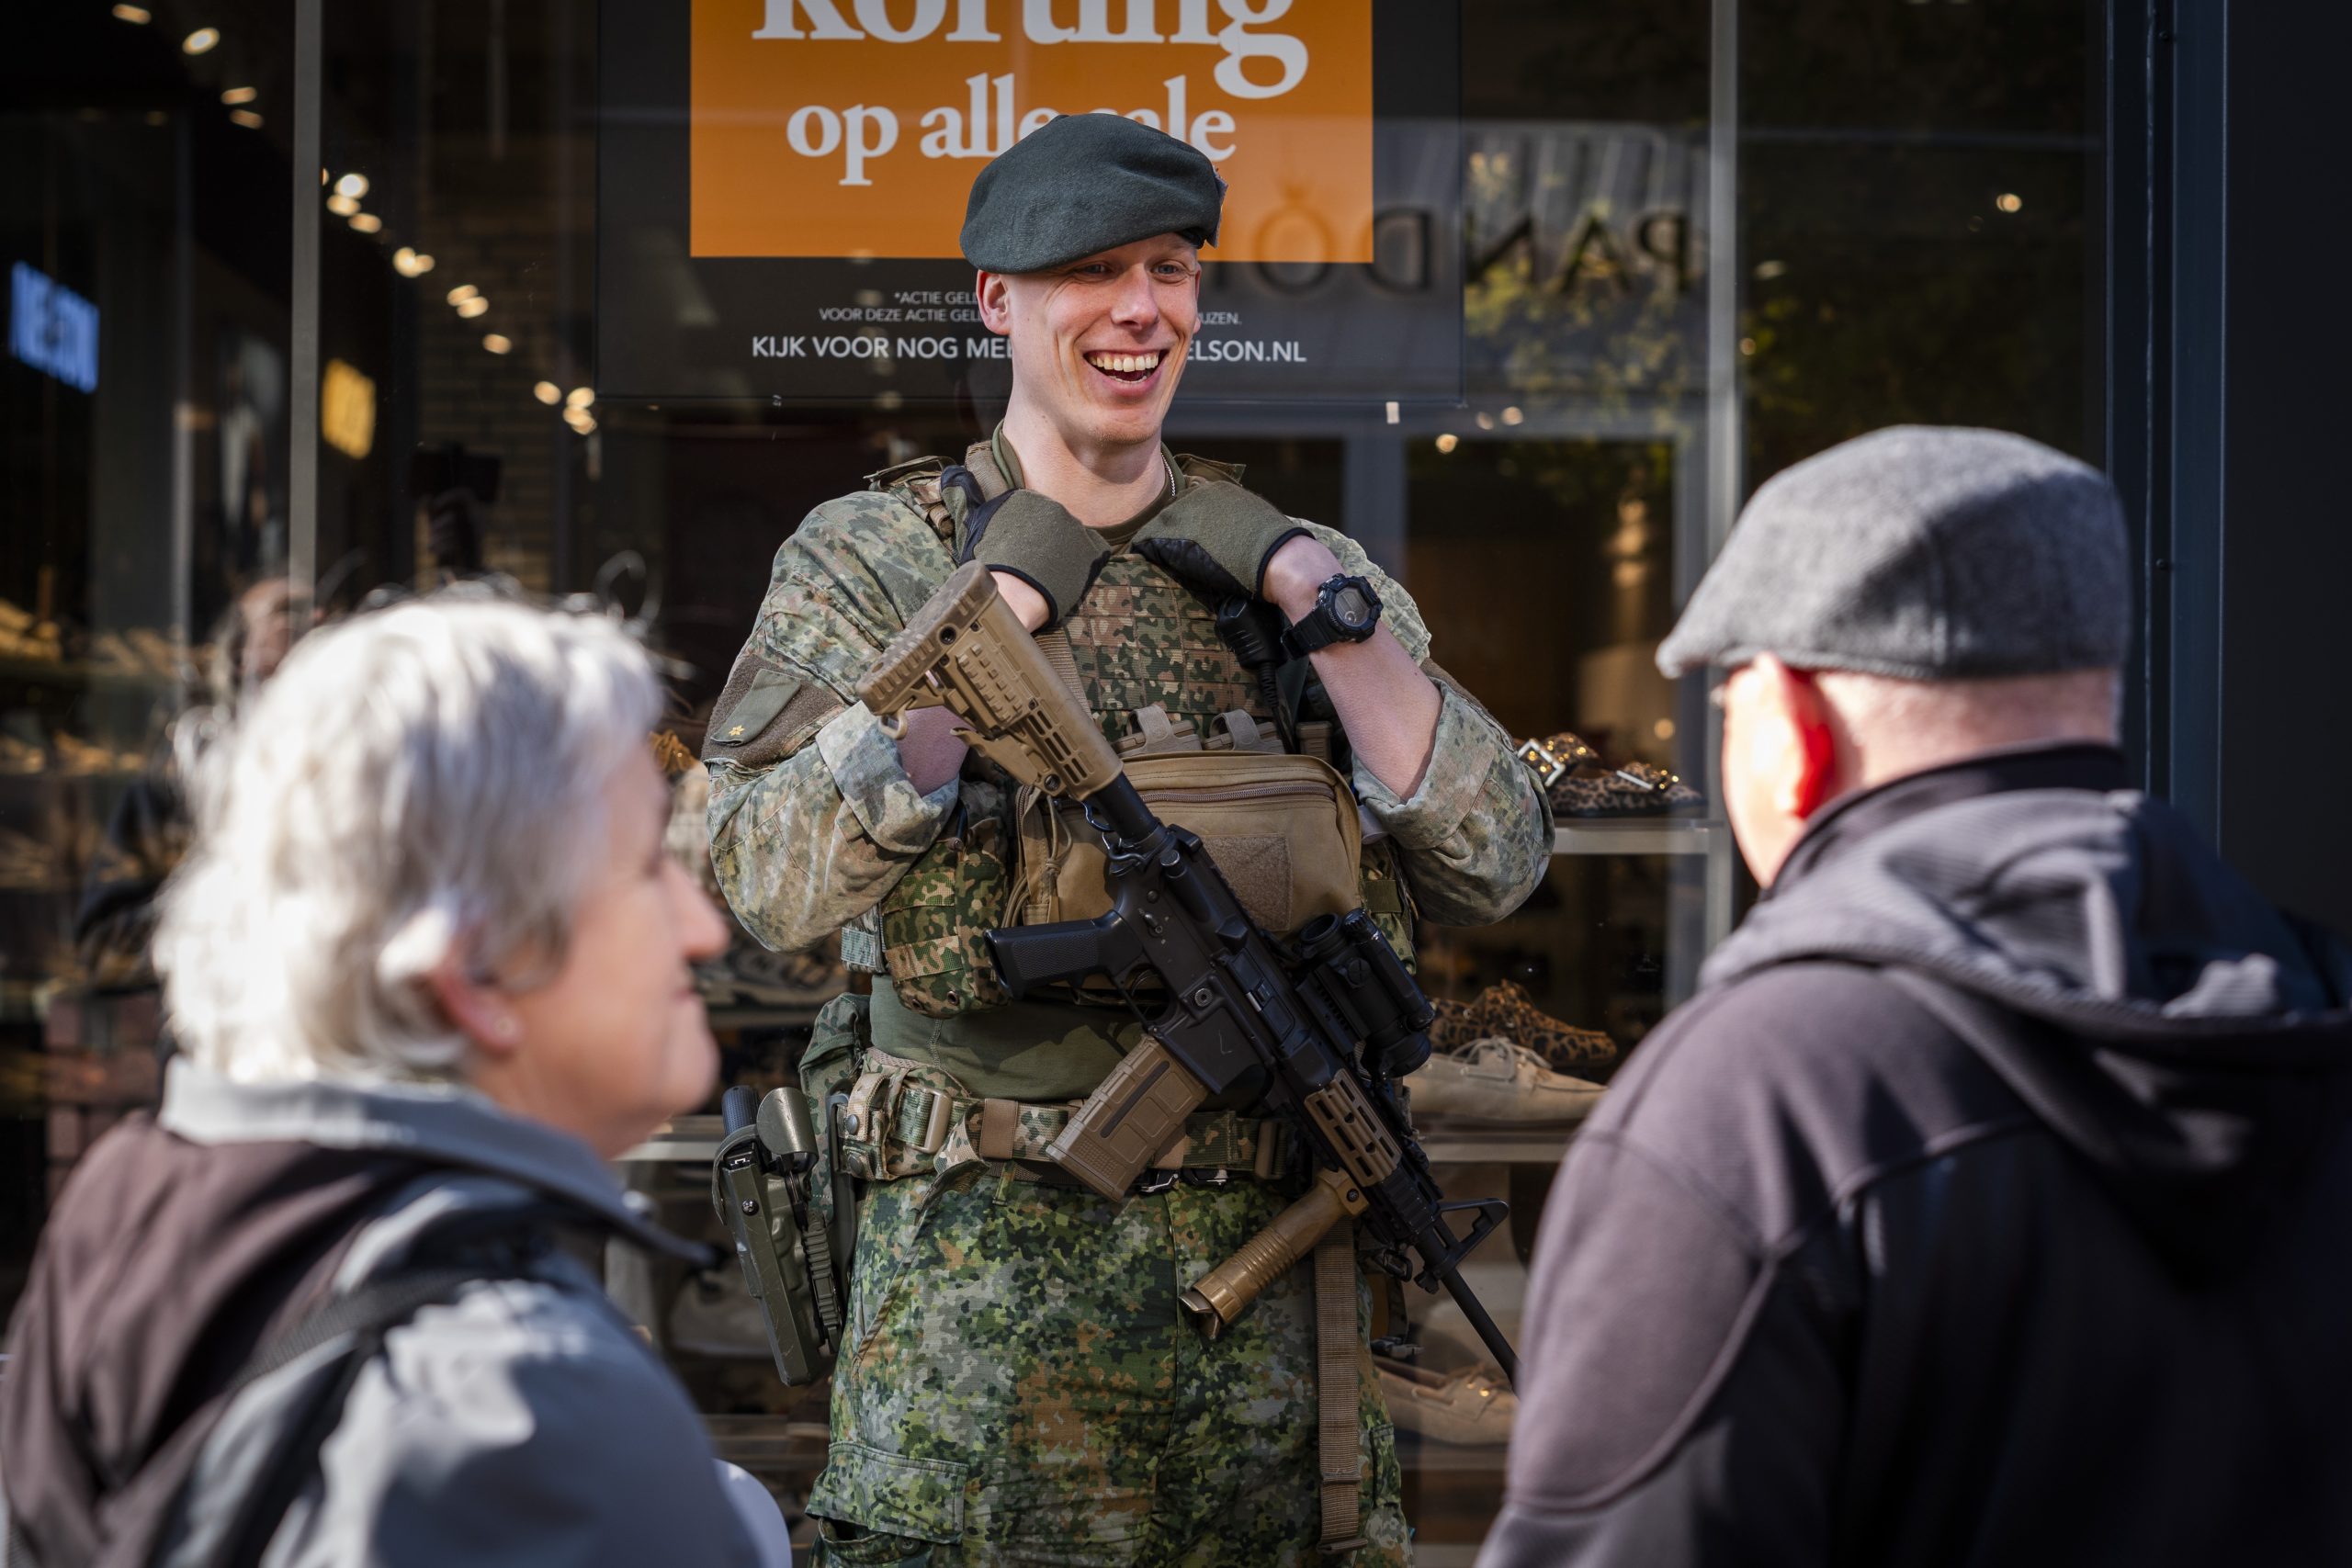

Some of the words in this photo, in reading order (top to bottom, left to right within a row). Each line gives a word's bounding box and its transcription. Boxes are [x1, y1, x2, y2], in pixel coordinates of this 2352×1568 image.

[787, 105, 899, 186] op
[1087, 74, 1236, 162] le
[820, 308, 862, 321] VOOR
[865, 309, 901, 321] DEZE
[904, 309, 946, 321] ACTIE
[752, 336, 806, 357] KIJK
[811, 336, 889, 358] VOOR
[897, 337, 958, 359] NOG
